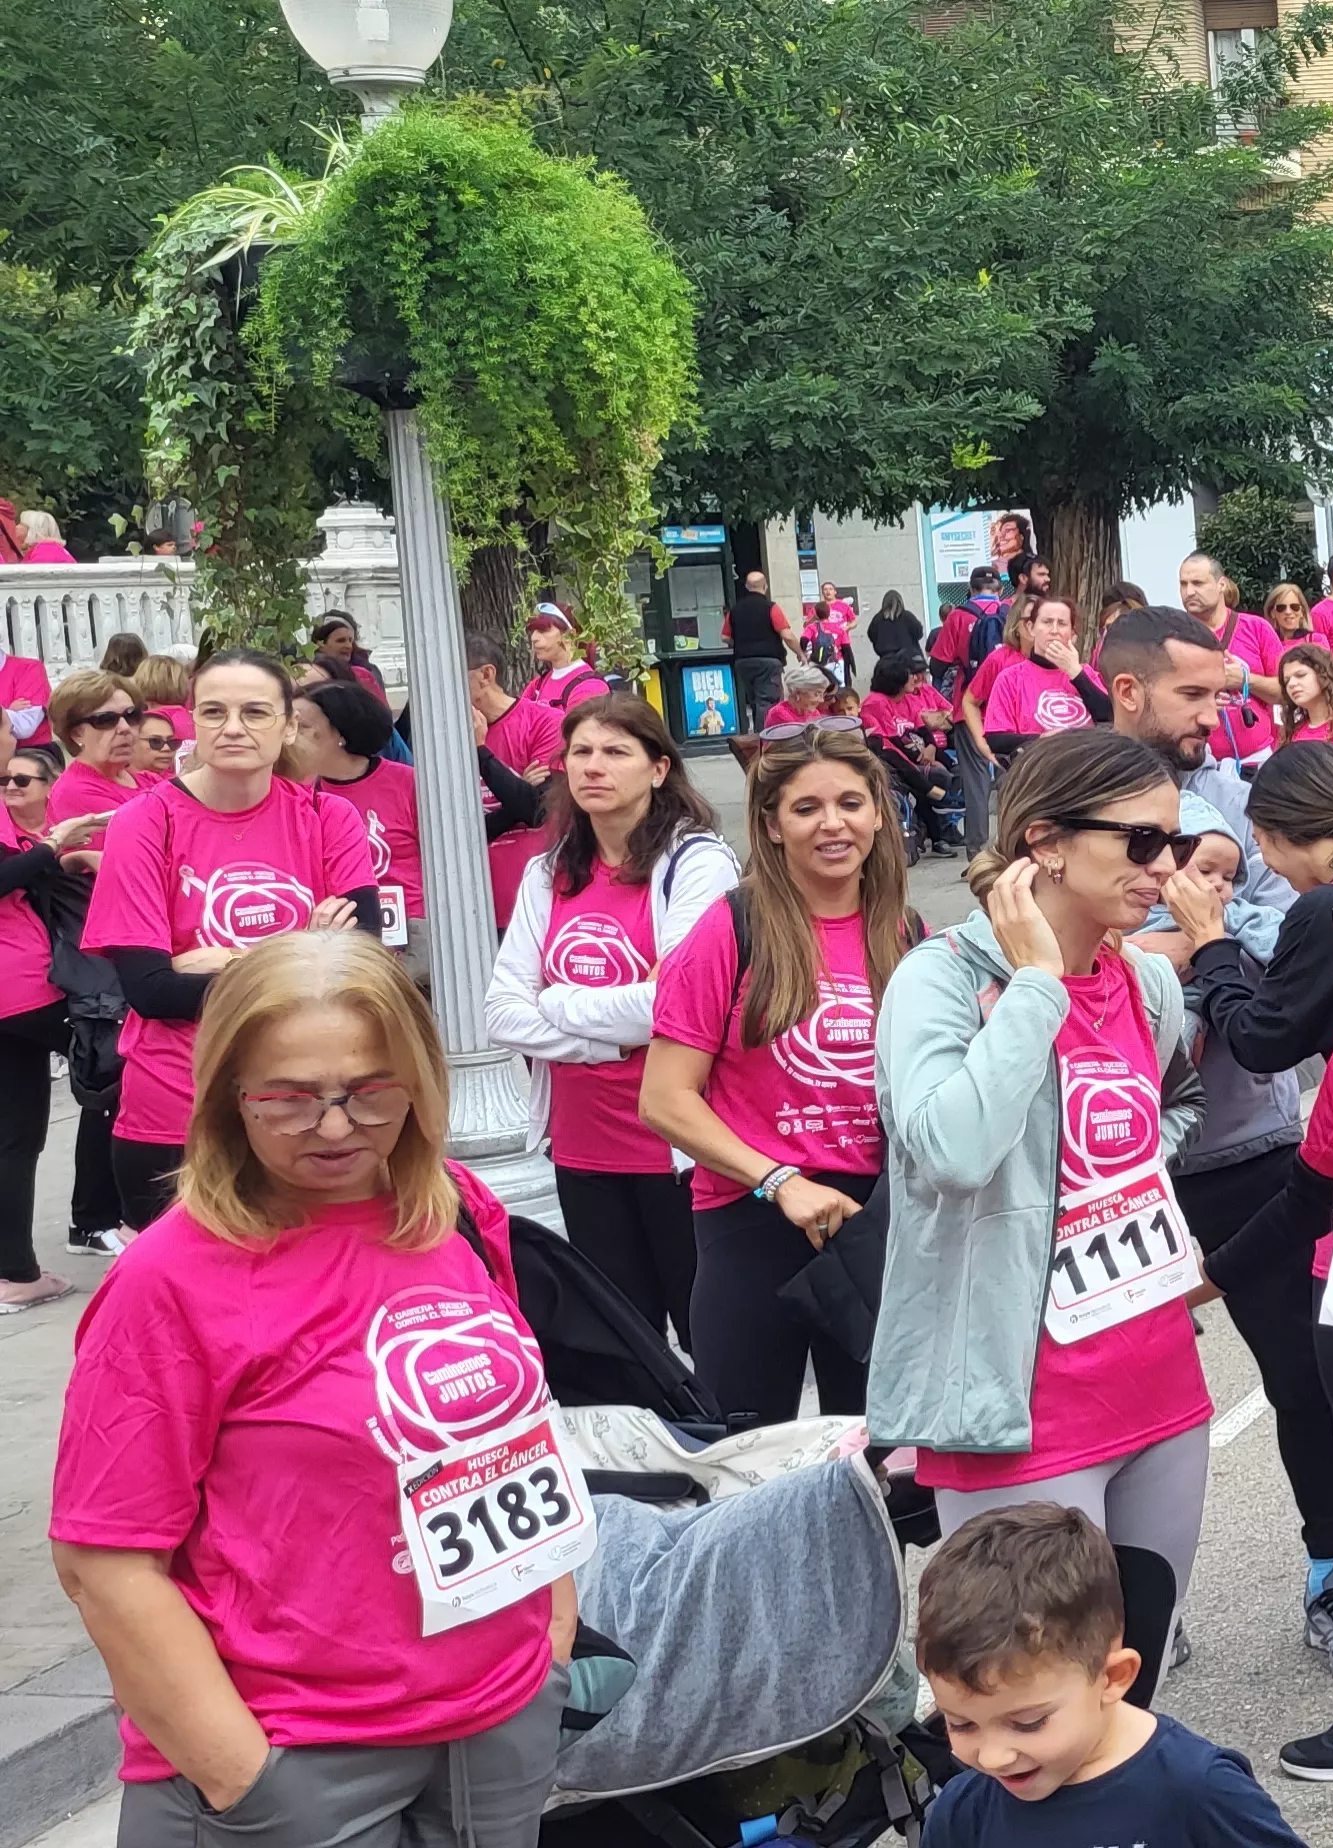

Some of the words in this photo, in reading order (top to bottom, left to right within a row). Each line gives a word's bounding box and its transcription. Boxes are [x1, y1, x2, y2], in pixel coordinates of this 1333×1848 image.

[239, 912, 276, 928] JUNTOS
[827, 1028, 870, 1041] JUNTOS
[1094, 1121, 1130, 1142] JUNTOS
[1056, 1213, 1101, 1240] ONTRA
[1102, 1208, 1119, 1219] EL
[1119, 1187, 1162, 1214] CÁNCER
[1088, 1192, 1125, 1214] HUESCA
[1052, 1208, 1179, 1295] 1111
[421, 1353, 492, 1386] Caminemos
[437, 1369, 497, 1404] JUNTOS
[420, 1473, 483, 1507] CONTRA
[484, 1465, 499, 1481] EL
[501, 1440, 548, 1474] CÁNCER
[467, 1446, 510, 1471] HUESCA
[426, 1466, 571, 1577] 3183
